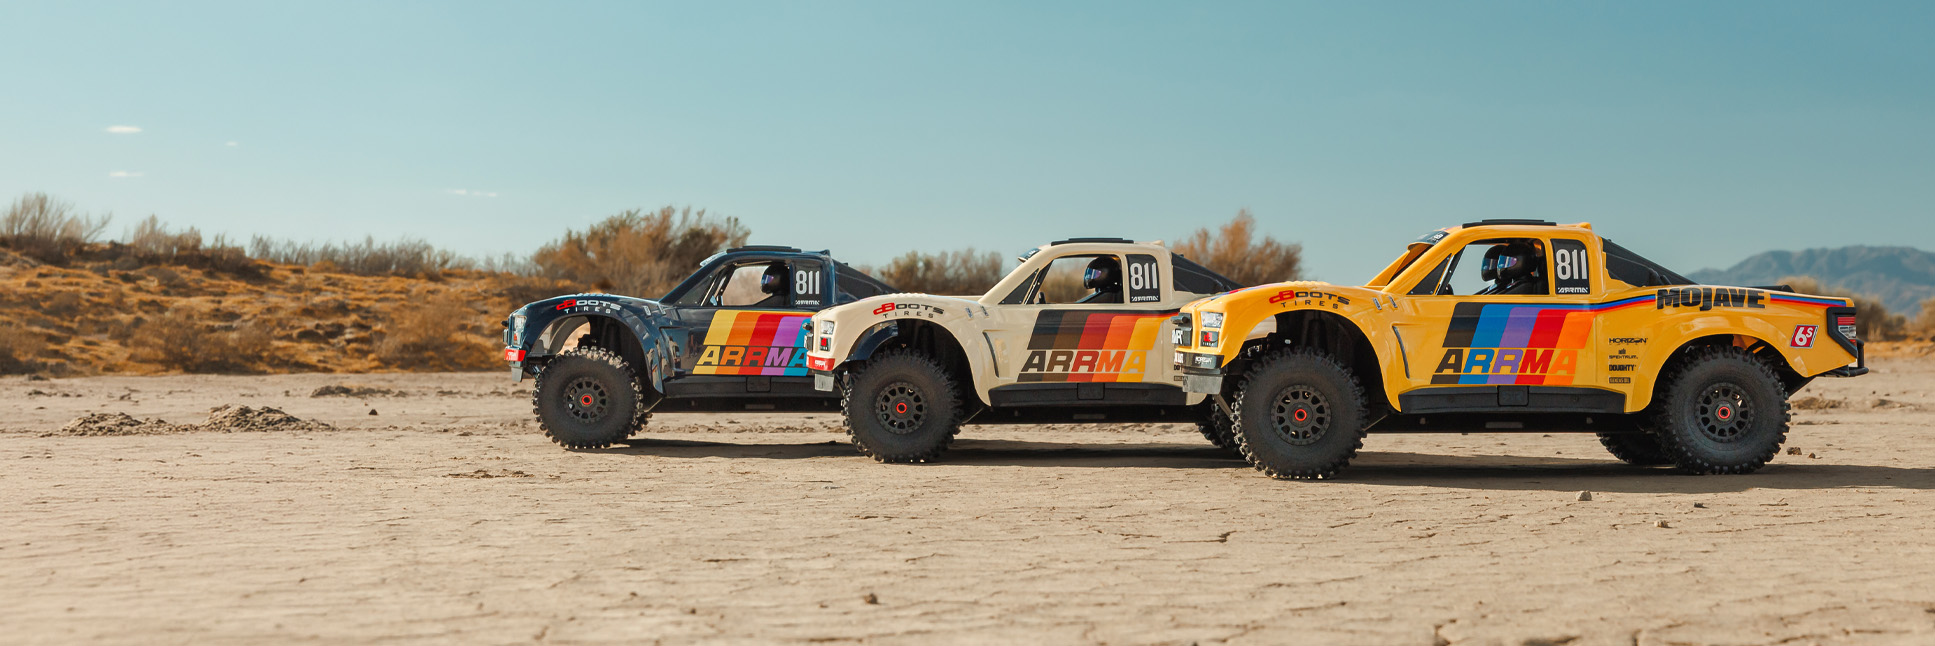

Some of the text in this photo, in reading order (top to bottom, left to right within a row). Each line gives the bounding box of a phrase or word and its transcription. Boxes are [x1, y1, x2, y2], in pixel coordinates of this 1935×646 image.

[1556, 248, 1588, 280] 811
[795, 270, 820, 295] 811
[1130, 262, 1158, 290] 811
[563, 306, 612, 314] TIRES
[1281, 299, 1339, 310] TIRES
[1657, 287, 1766, 311] MOJAVE
[883, 311, 934, 319] TIRES
[696, 345, 809, 367] ARRMA
[1021, 350, 1147, 373] ARRMA
[1434, 348, 1578, 374] ARRMA
[1608, 364, 1635, 372] DOUGHTY
